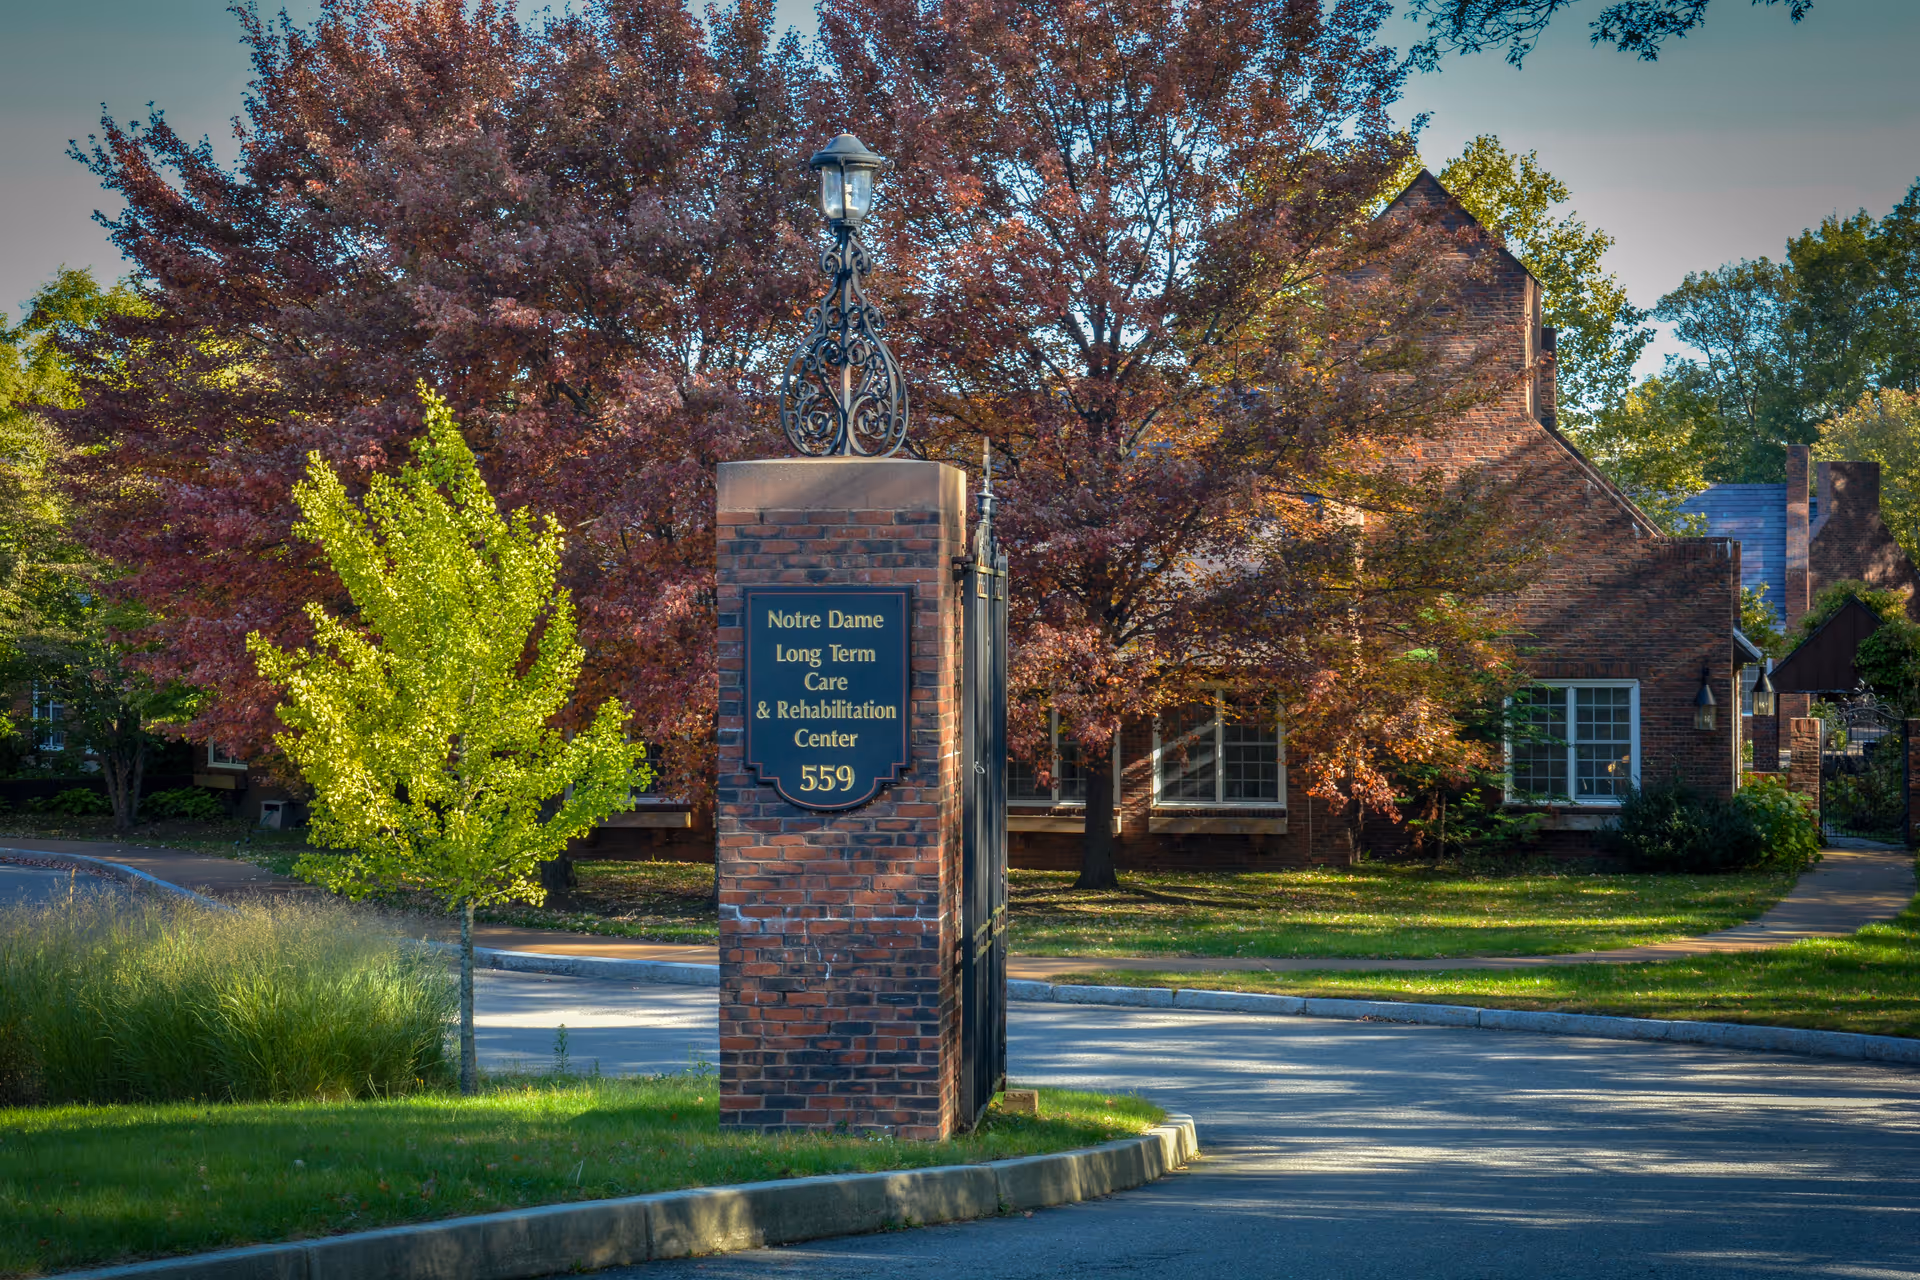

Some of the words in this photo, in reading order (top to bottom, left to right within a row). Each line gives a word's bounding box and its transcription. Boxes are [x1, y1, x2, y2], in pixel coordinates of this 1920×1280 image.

[768, 610, 821, 628] Notre
[828, 610, 884, 628] Dame
[776, 644, 822, 667] Long
[829, 644, 876, 662] Term
[804, 672, 848, 690] Care
[756, 701, 771, 719] &
[777, 700, 897, 719] Rehabilitation
[794, 729, 858, 747] Center
[800, 765, 855, 791] 559
